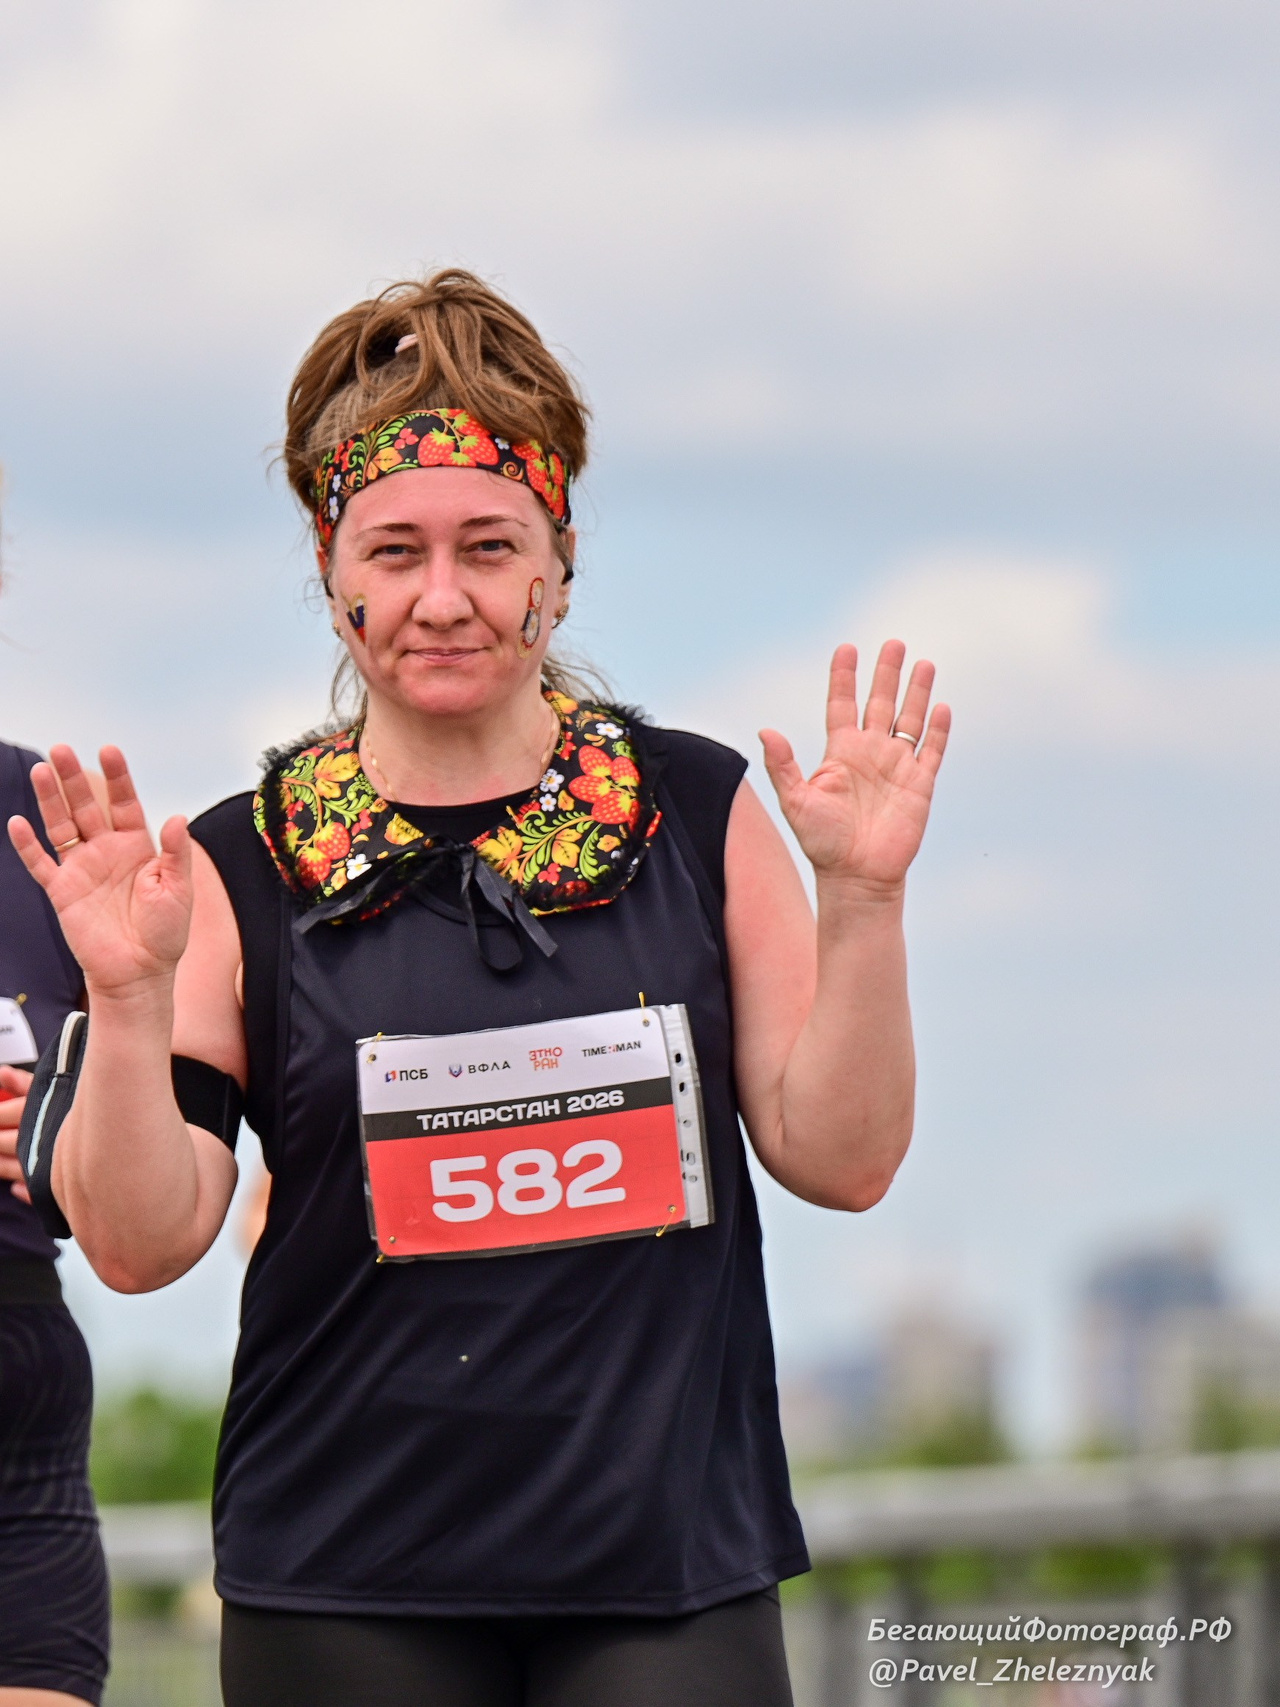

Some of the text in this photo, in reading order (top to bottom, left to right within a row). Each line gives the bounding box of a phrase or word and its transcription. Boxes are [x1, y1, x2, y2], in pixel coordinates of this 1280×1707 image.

[467, 1060, 511, 1075] ВФЛА
[533, 1057, 559, 1072] РАН
[399, 1068, 428, 1082] ПСБ
[416, 1089, 625, 1131] ТАТАРСТАН 2026
[429, 1138, 627, 1224] 582
